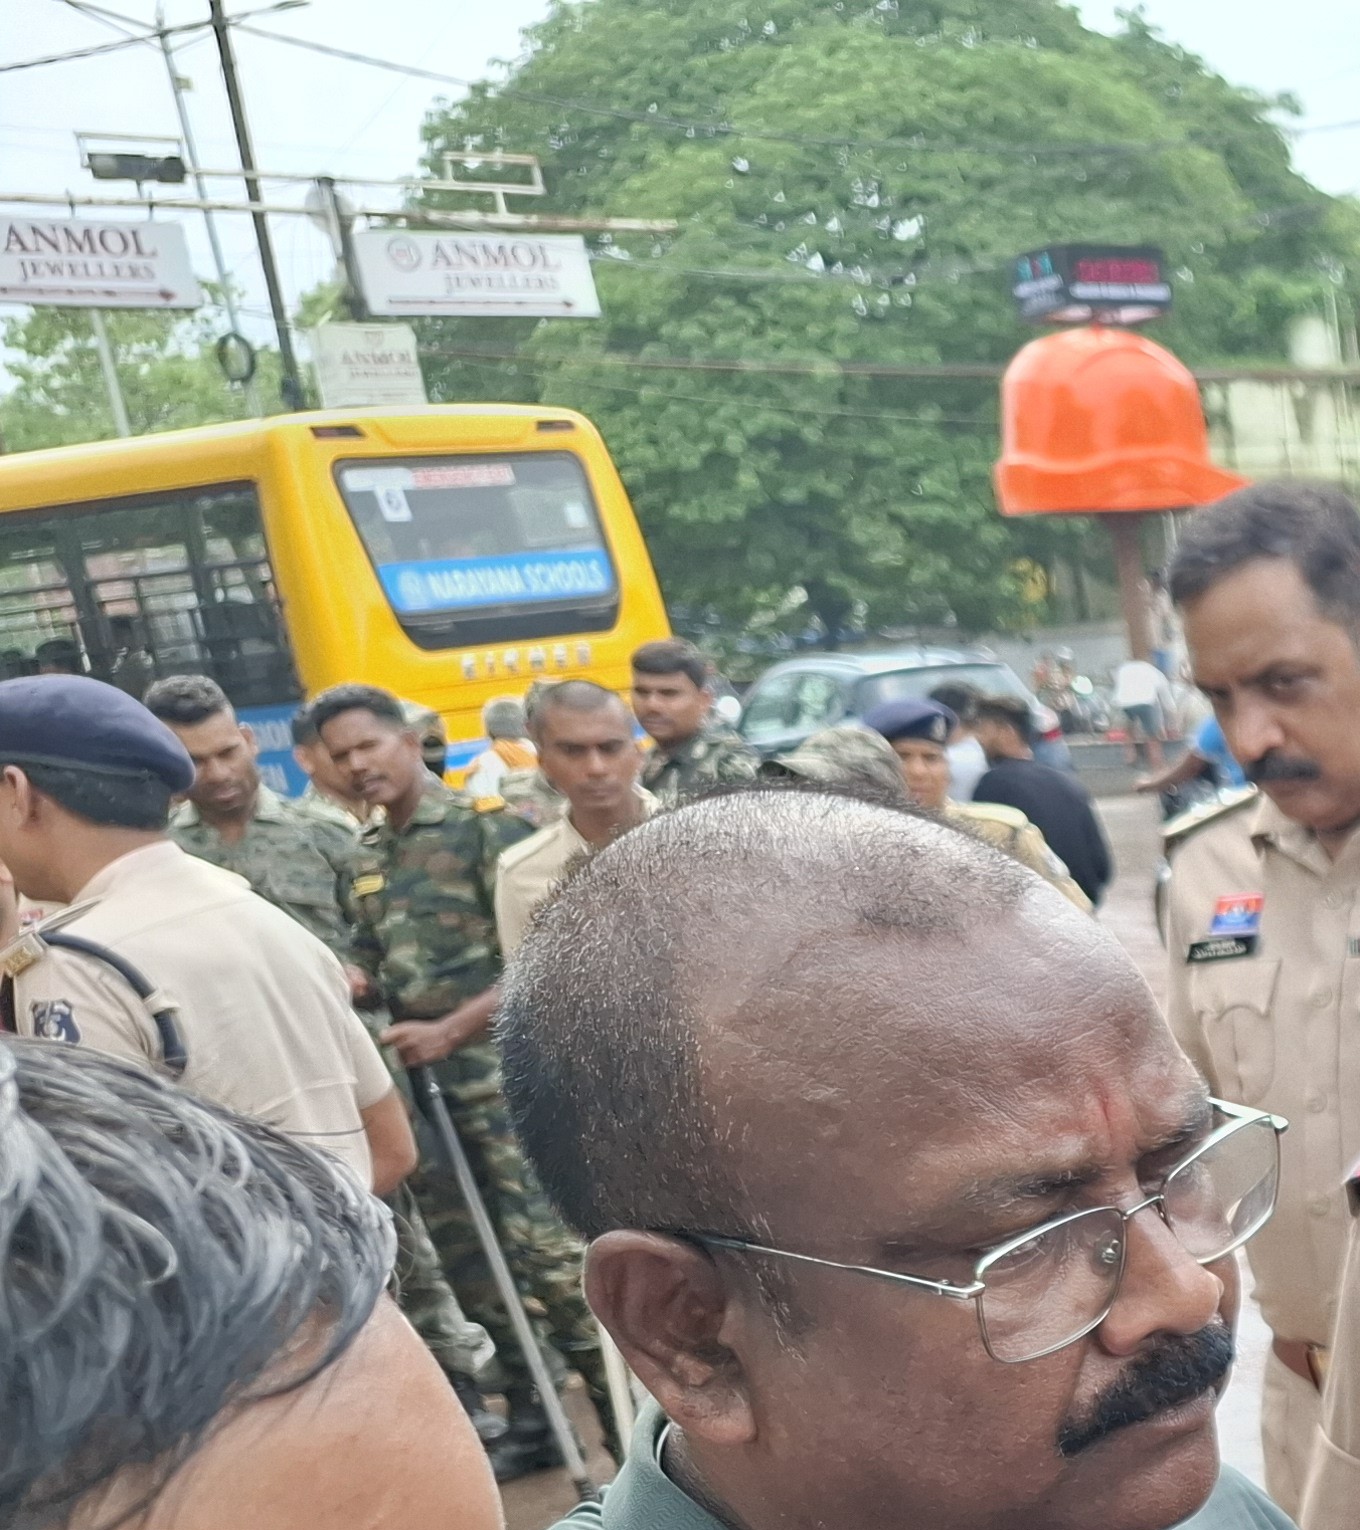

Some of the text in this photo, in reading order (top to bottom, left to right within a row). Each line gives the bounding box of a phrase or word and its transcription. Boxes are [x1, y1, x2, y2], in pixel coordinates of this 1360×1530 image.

[6, 223, 157, 256] ANMOL
[432, 240, 561, 270] ANMOL
[20, 260, 155, 281] JEWELLERS
[524, 560, 604, 593] SCHOOLS
